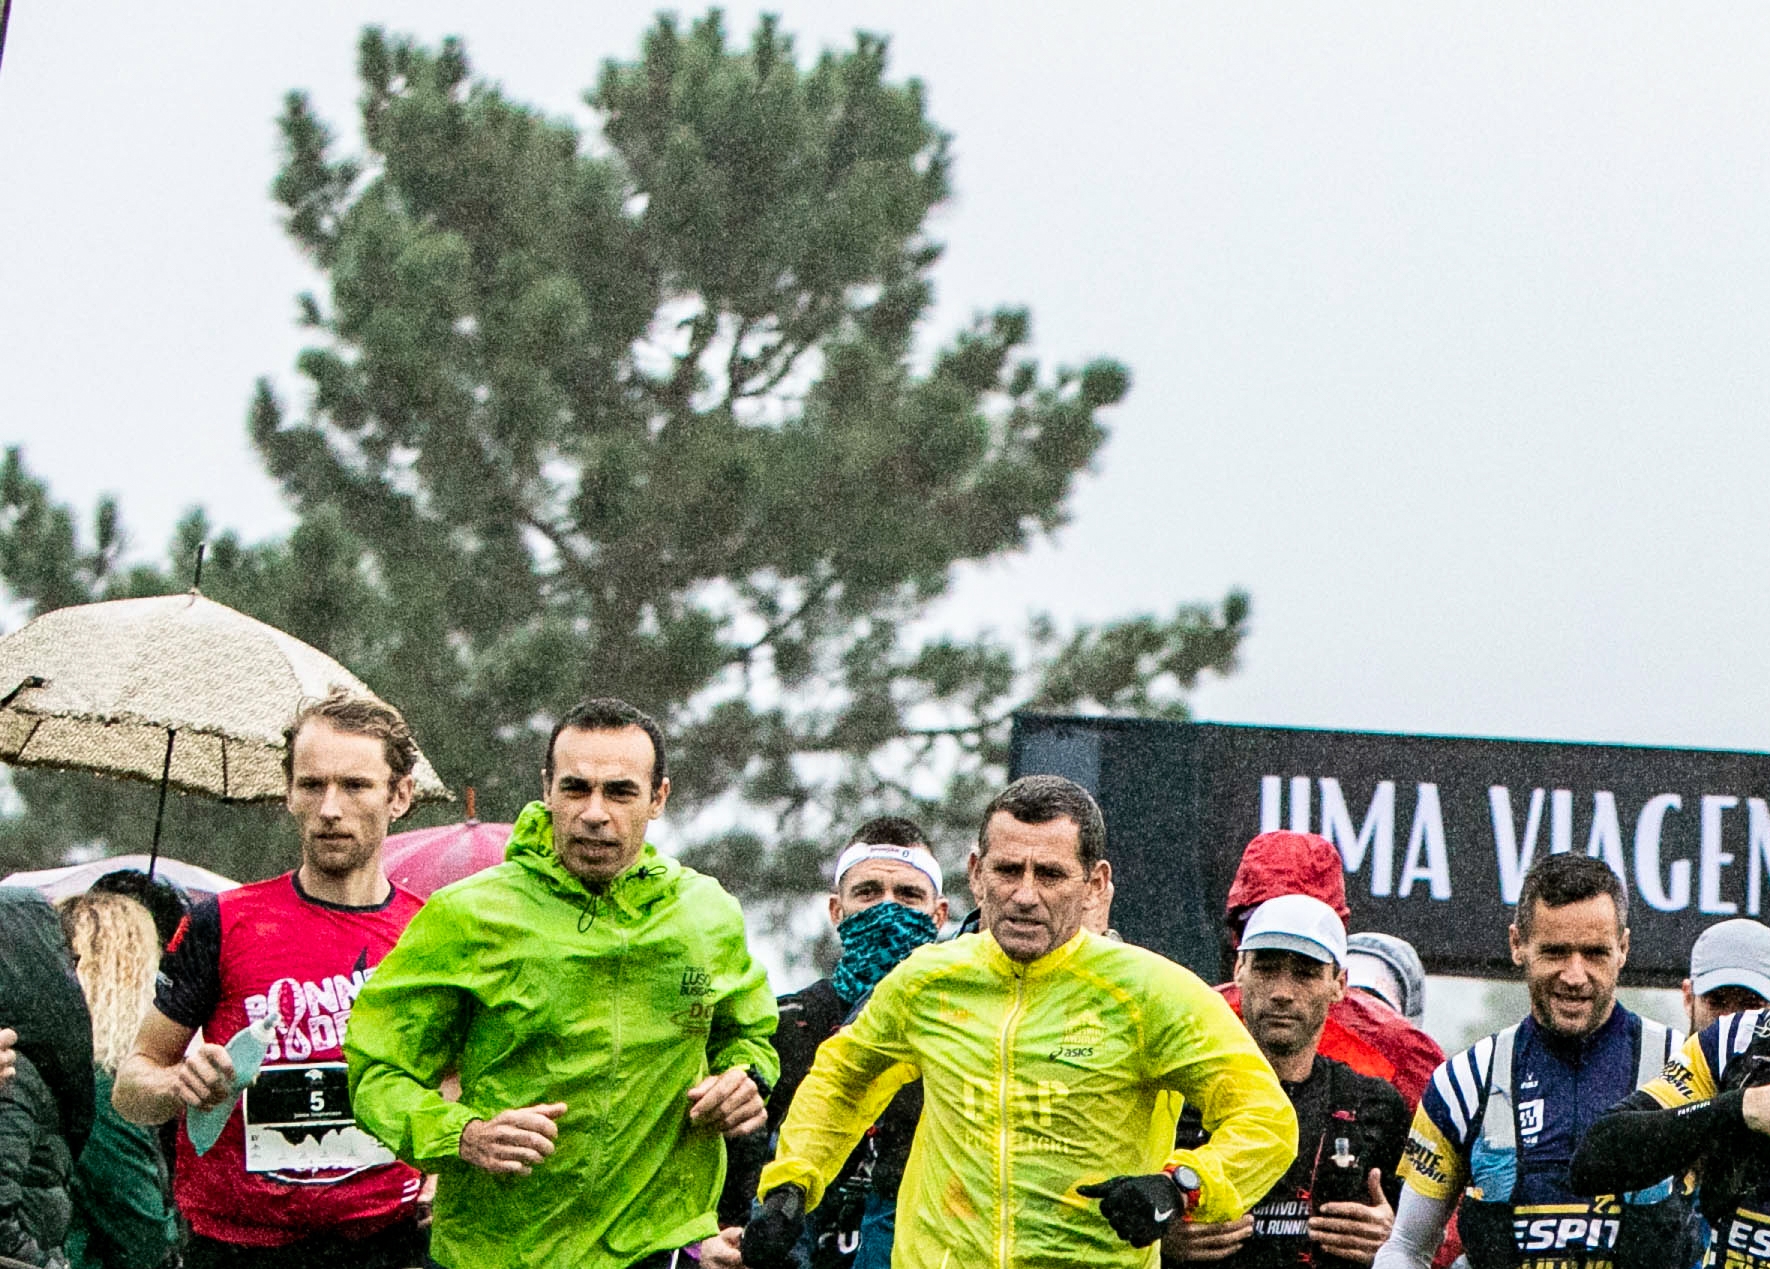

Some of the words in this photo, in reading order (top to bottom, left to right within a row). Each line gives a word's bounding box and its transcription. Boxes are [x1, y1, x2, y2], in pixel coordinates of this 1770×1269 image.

[1064, 1047, 1093, 1057] asics
[310, 1091, 325, 1111] 5
[1514, 1219, 1620, 1250] ESPIT
